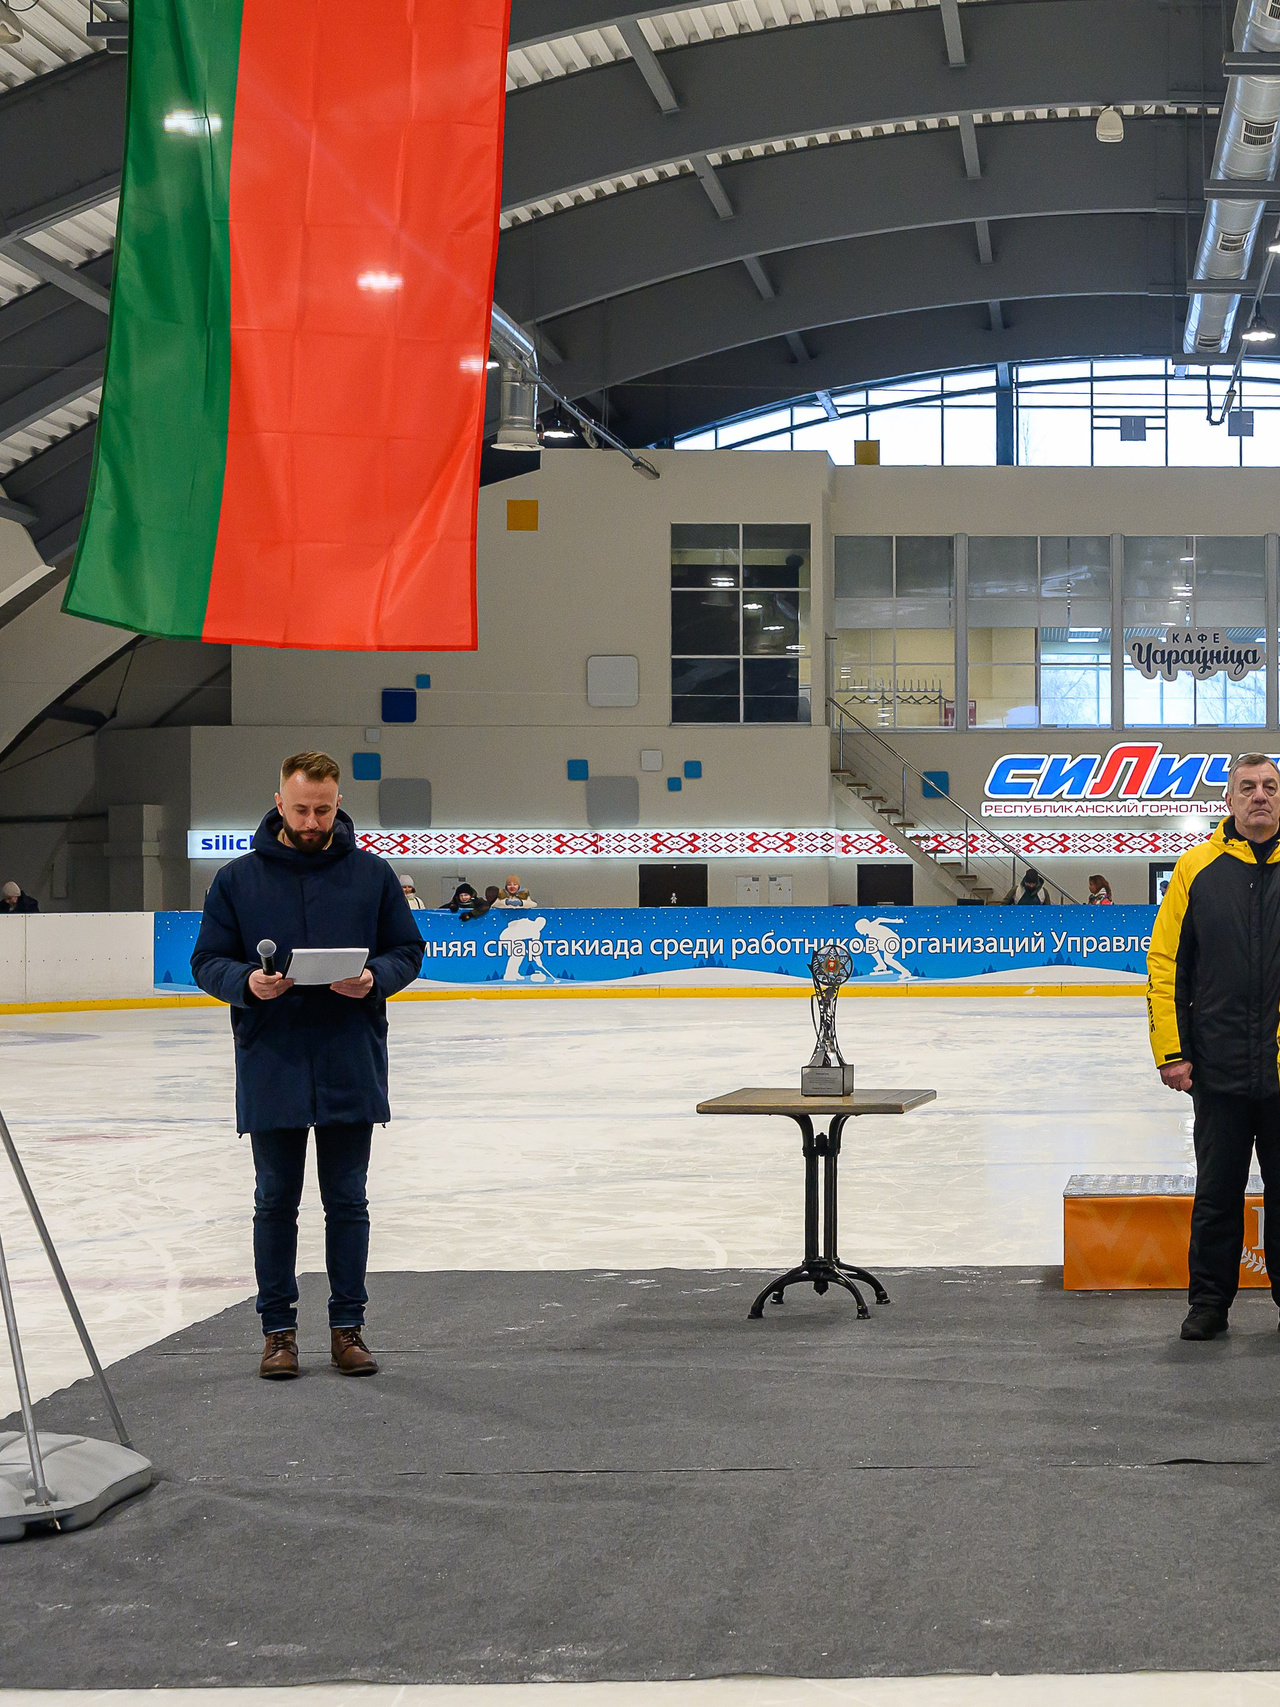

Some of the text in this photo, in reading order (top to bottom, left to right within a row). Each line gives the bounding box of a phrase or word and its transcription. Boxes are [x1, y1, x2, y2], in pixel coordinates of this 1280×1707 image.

[1171, 632, 1220, 644] КАФЕ
[984, 802, 1139, 814] РЕСПУБЛИКАНСКИЙ
[1141, 803, 1227, 813] ГОРНОЛЫЖ
[201, 834, 254, 851] silic
[424, 940, 477, 958] няя
[483, 938, 643, 962] спартакиада
[649, 937, 724, 961] среди
[884, 930, 1045, 959] организаций
[1050, 931, 1152, 958] Управле
